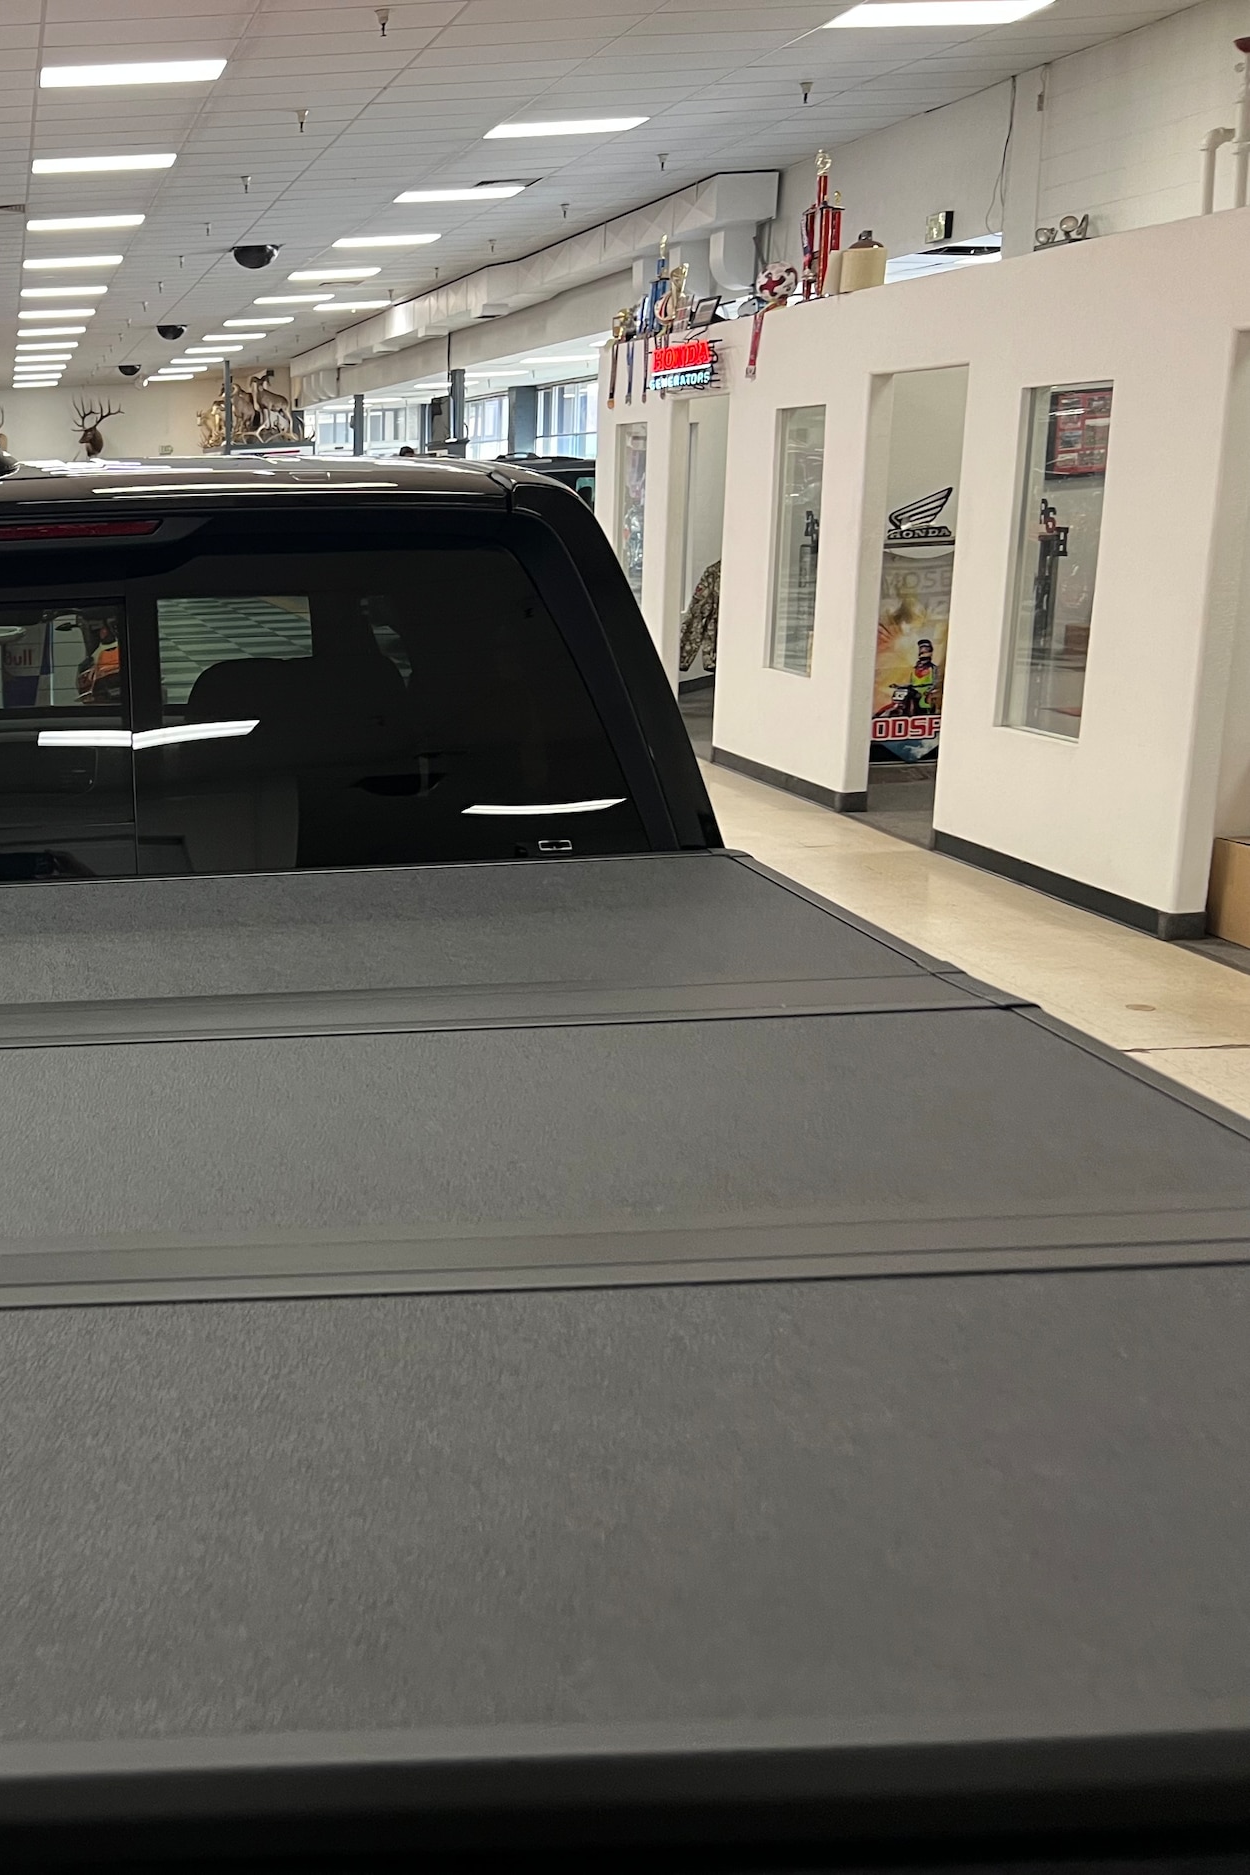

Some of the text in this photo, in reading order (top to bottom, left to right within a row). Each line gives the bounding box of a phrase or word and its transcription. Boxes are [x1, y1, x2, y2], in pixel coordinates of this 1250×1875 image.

[652, 340, 711, 372] HONDA
[650, 371, 711, 391] GENERATORS
[889, 528, 951, 539] HONDA
